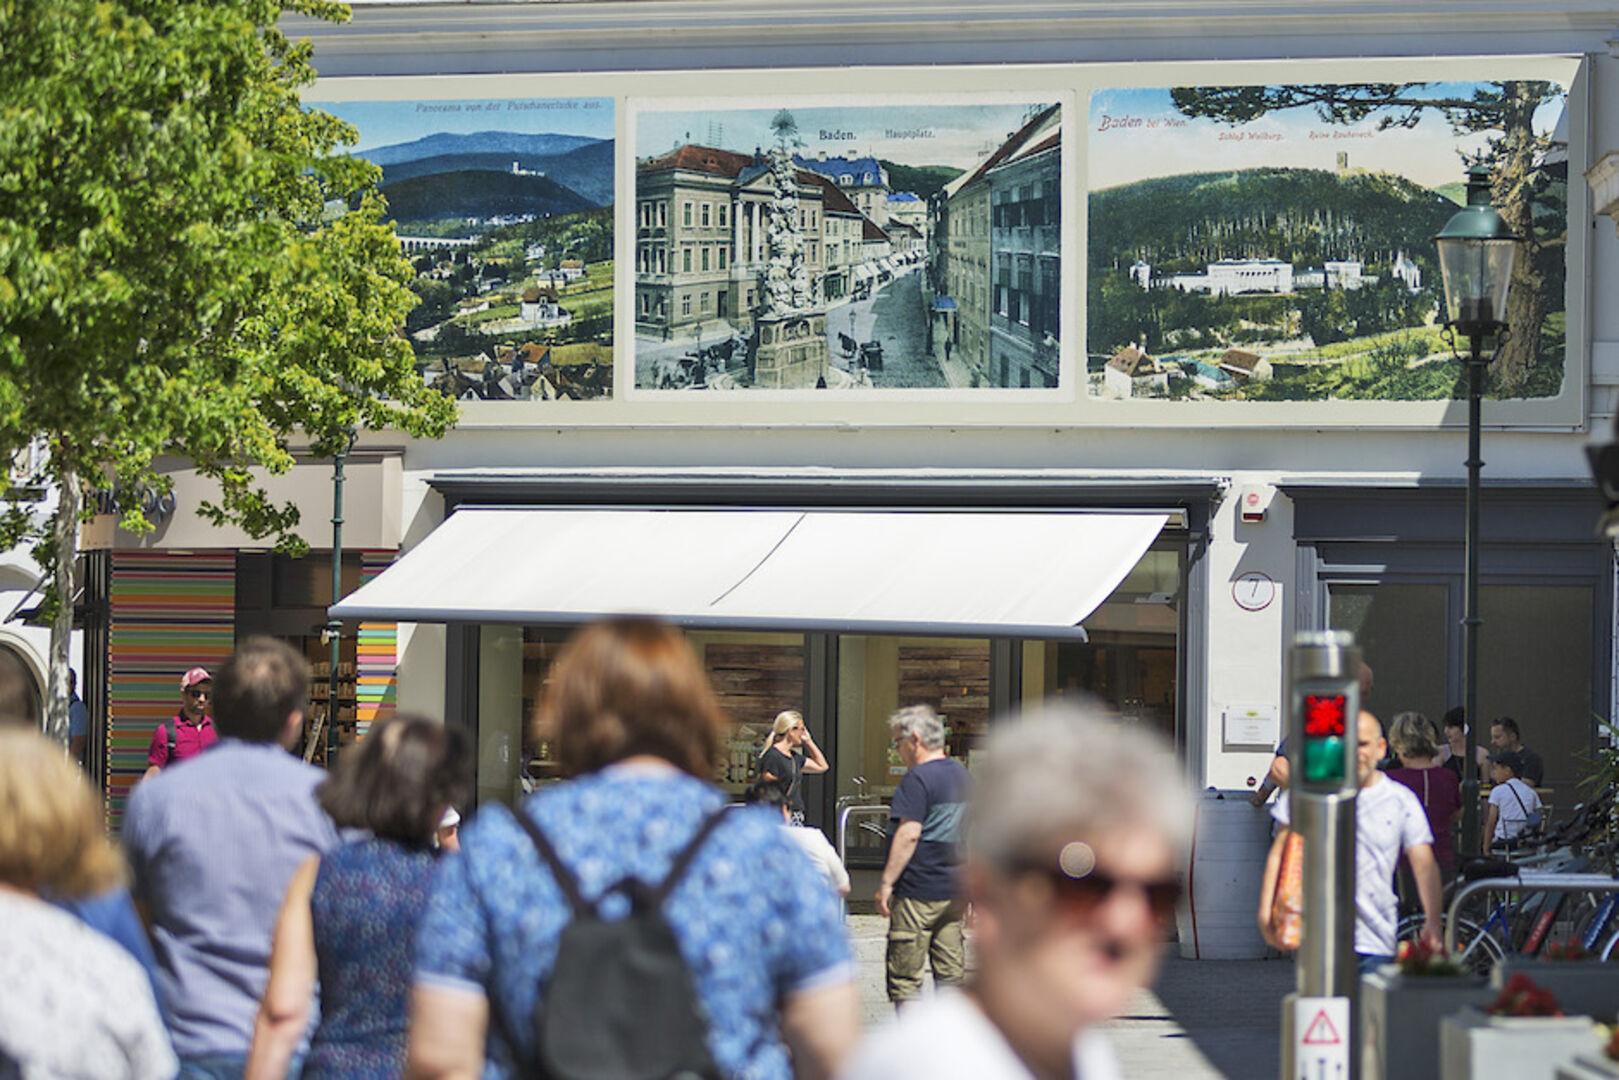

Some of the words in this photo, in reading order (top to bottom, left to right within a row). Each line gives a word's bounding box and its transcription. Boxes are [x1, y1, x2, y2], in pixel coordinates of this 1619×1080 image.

[416, 103, 461, 112] Panorama
[465, 103, 481, 112] von
[486, 101, 501, 111] der
[1098, 115, 1143, 131] Baden
[1146, 118, 1160, 128] bei
[819, 129, 856, 140] Baden.
[885, 128, 936, 140] Hauptplatz.
[1248, 577, 1260, 598] 7
